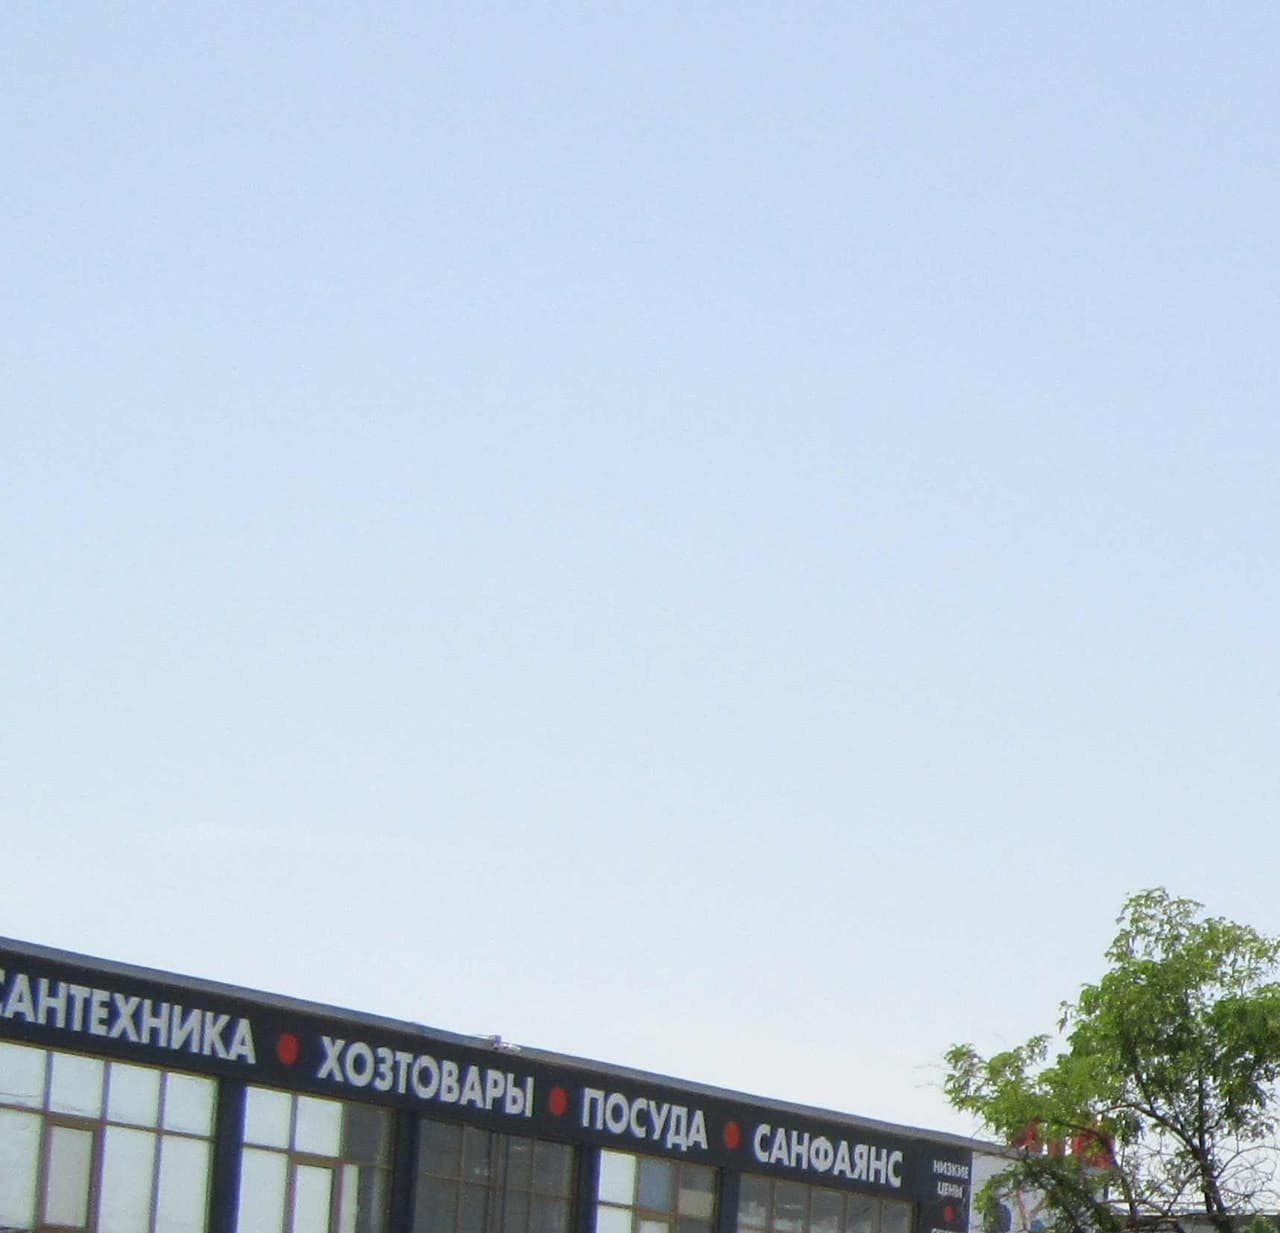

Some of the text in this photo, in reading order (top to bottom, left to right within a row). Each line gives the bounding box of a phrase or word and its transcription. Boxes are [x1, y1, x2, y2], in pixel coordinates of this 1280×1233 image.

[0, 968, 903, 1188] АНТЕХНИКА ХОЗТОВАРЫ ПОСУДА САНФАЯНС
[933, 1159, 969, 1179] НИЗКИЕ
